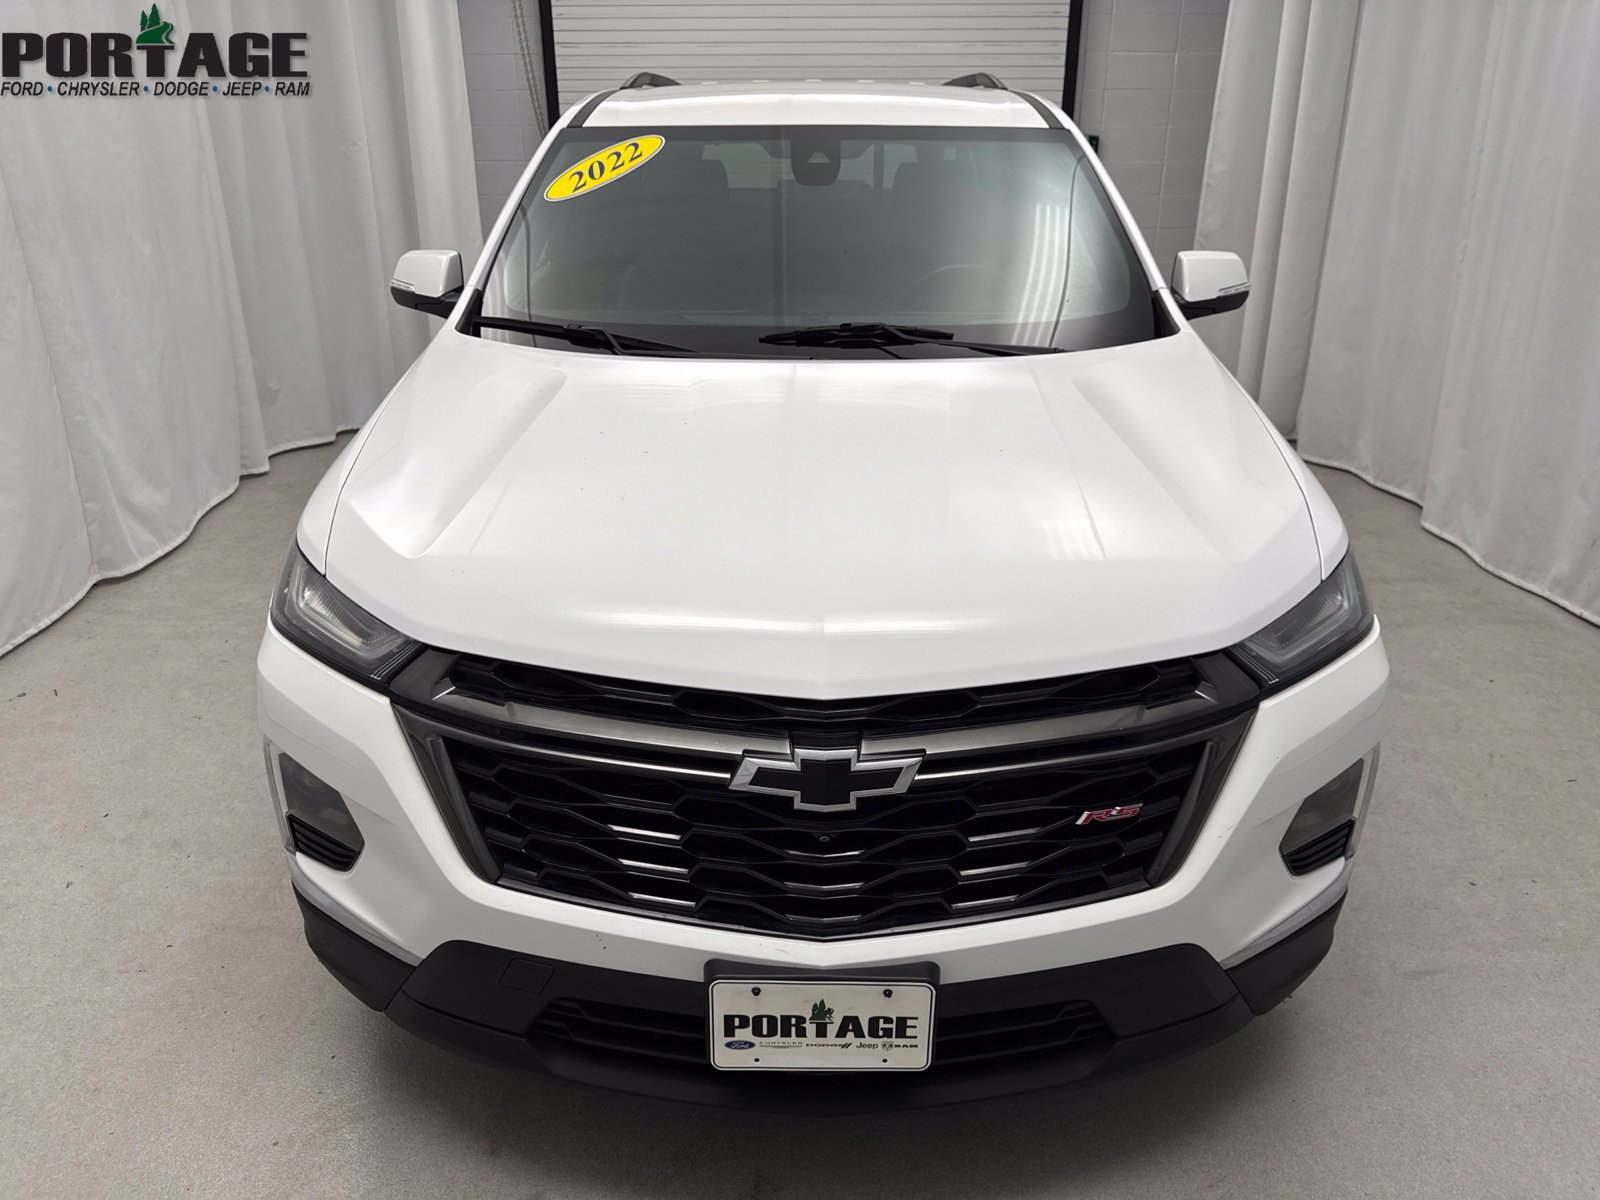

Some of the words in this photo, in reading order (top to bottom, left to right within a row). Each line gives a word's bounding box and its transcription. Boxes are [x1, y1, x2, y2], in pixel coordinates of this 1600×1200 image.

[568, 142, 643, 193] 2022
[1075, 803, 1144, 825] RS
[723, 1014, 919, 1039] PORTAGE
[856, 1042, 879, 1050] Jeep
